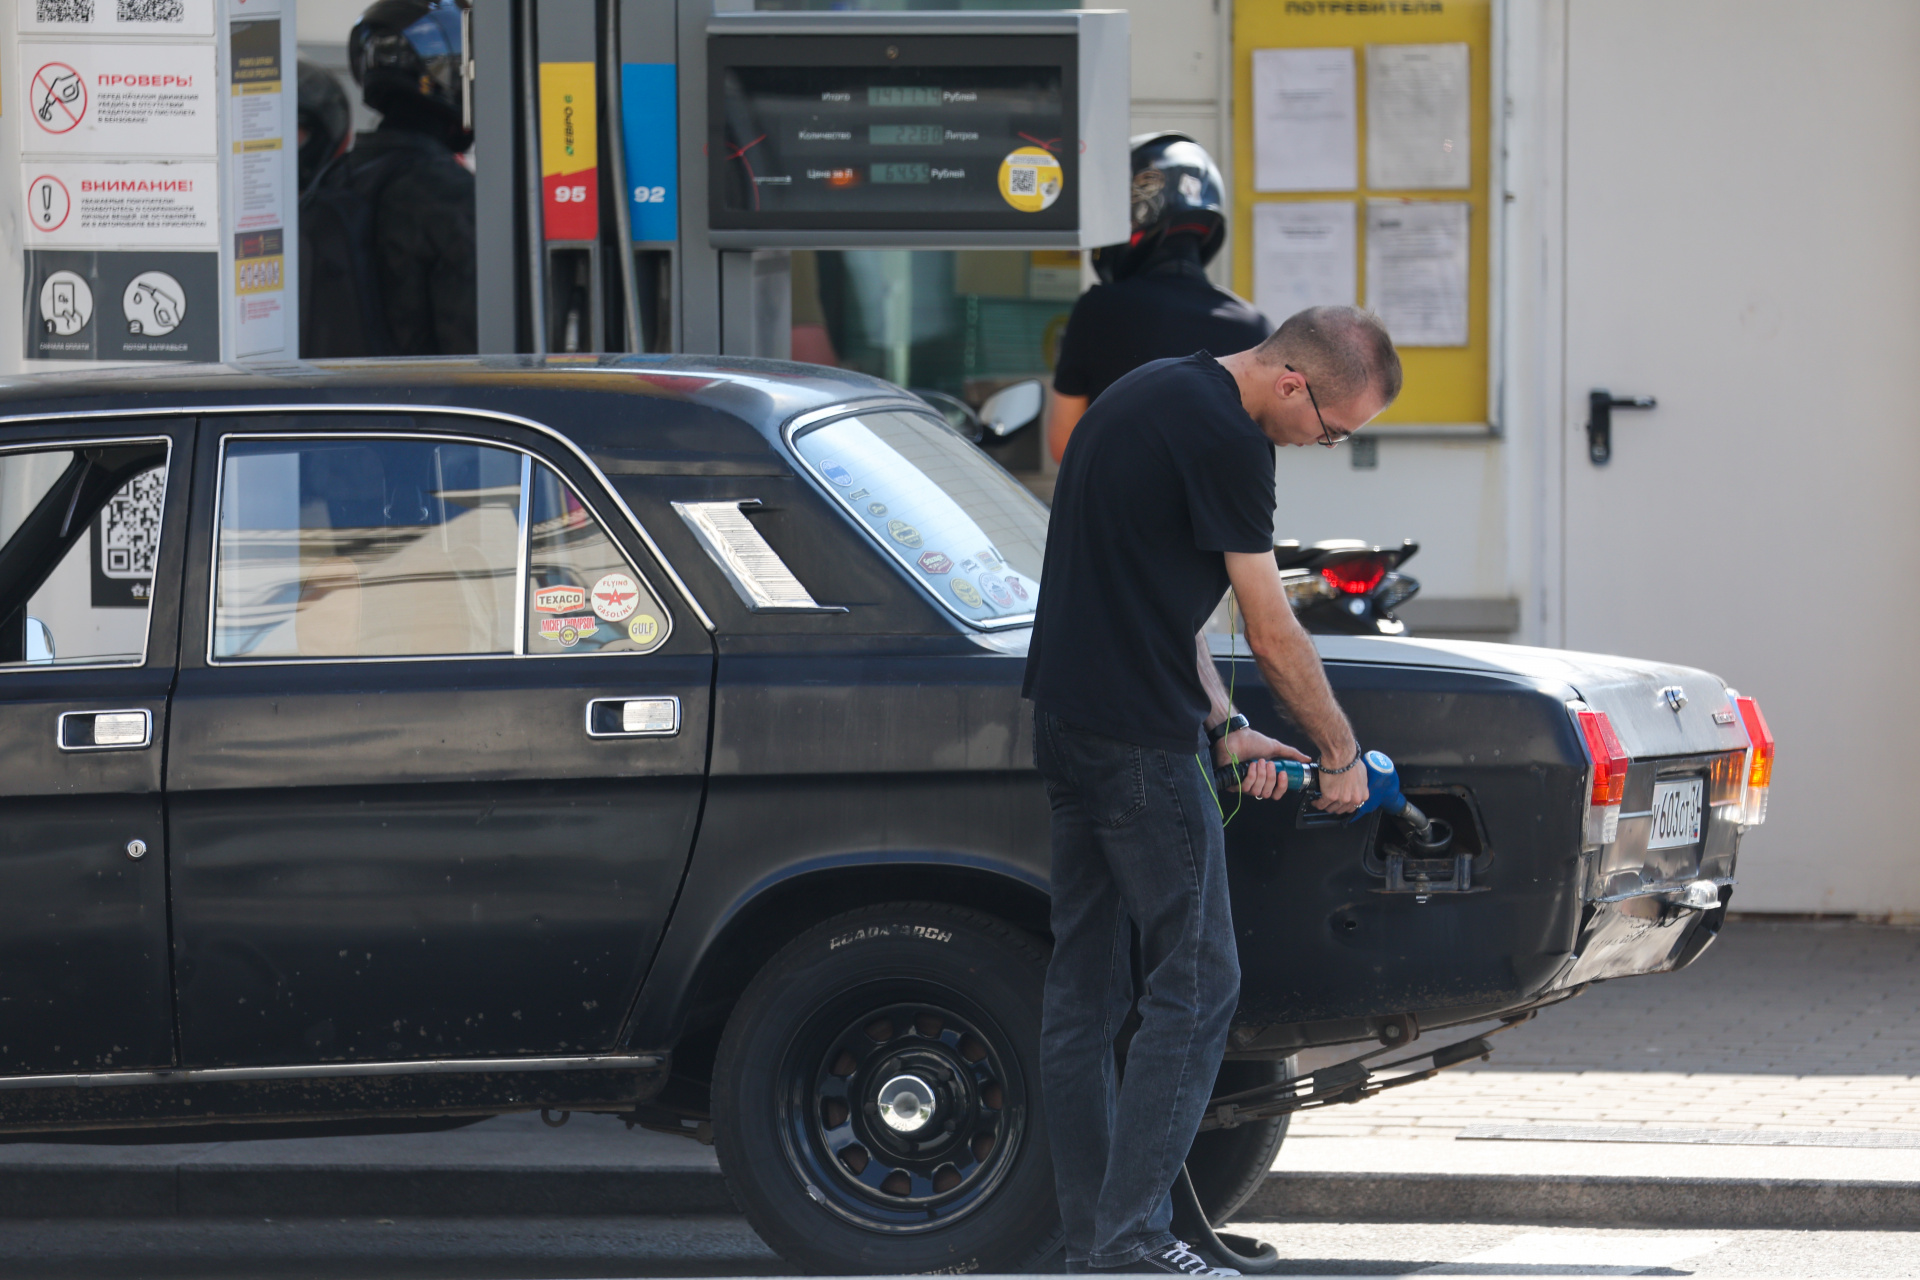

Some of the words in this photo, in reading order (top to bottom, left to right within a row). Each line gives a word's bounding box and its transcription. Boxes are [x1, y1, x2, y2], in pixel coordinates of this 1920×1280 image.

[98, 74, 192, 87] ПРОВЕРЬ!
[822, 92, 851, 101] Итого
[943, 91, 977, 103] Рублей
[798, 130, 851, 140] Количество
[944, 131, 979, 142] Литров
[807, 169, 831, 179] Цена
[931, 169, 965, 180] Рублей
[81, 180, 193, 192] ВНИМАНИЕ!
[555, 186, 586, 203] 95
[634, 186, 666, 203] 92
[130, 320, 141, 333] 2
[539, 594, 580, 605] TEXACO
[597, 604, 633, 618] GASOLINE
[542, 618, 563, 631] MICKEY
[564, 617, 595, 630] THOMPSON
[632, 622, 654, 635] GULF
